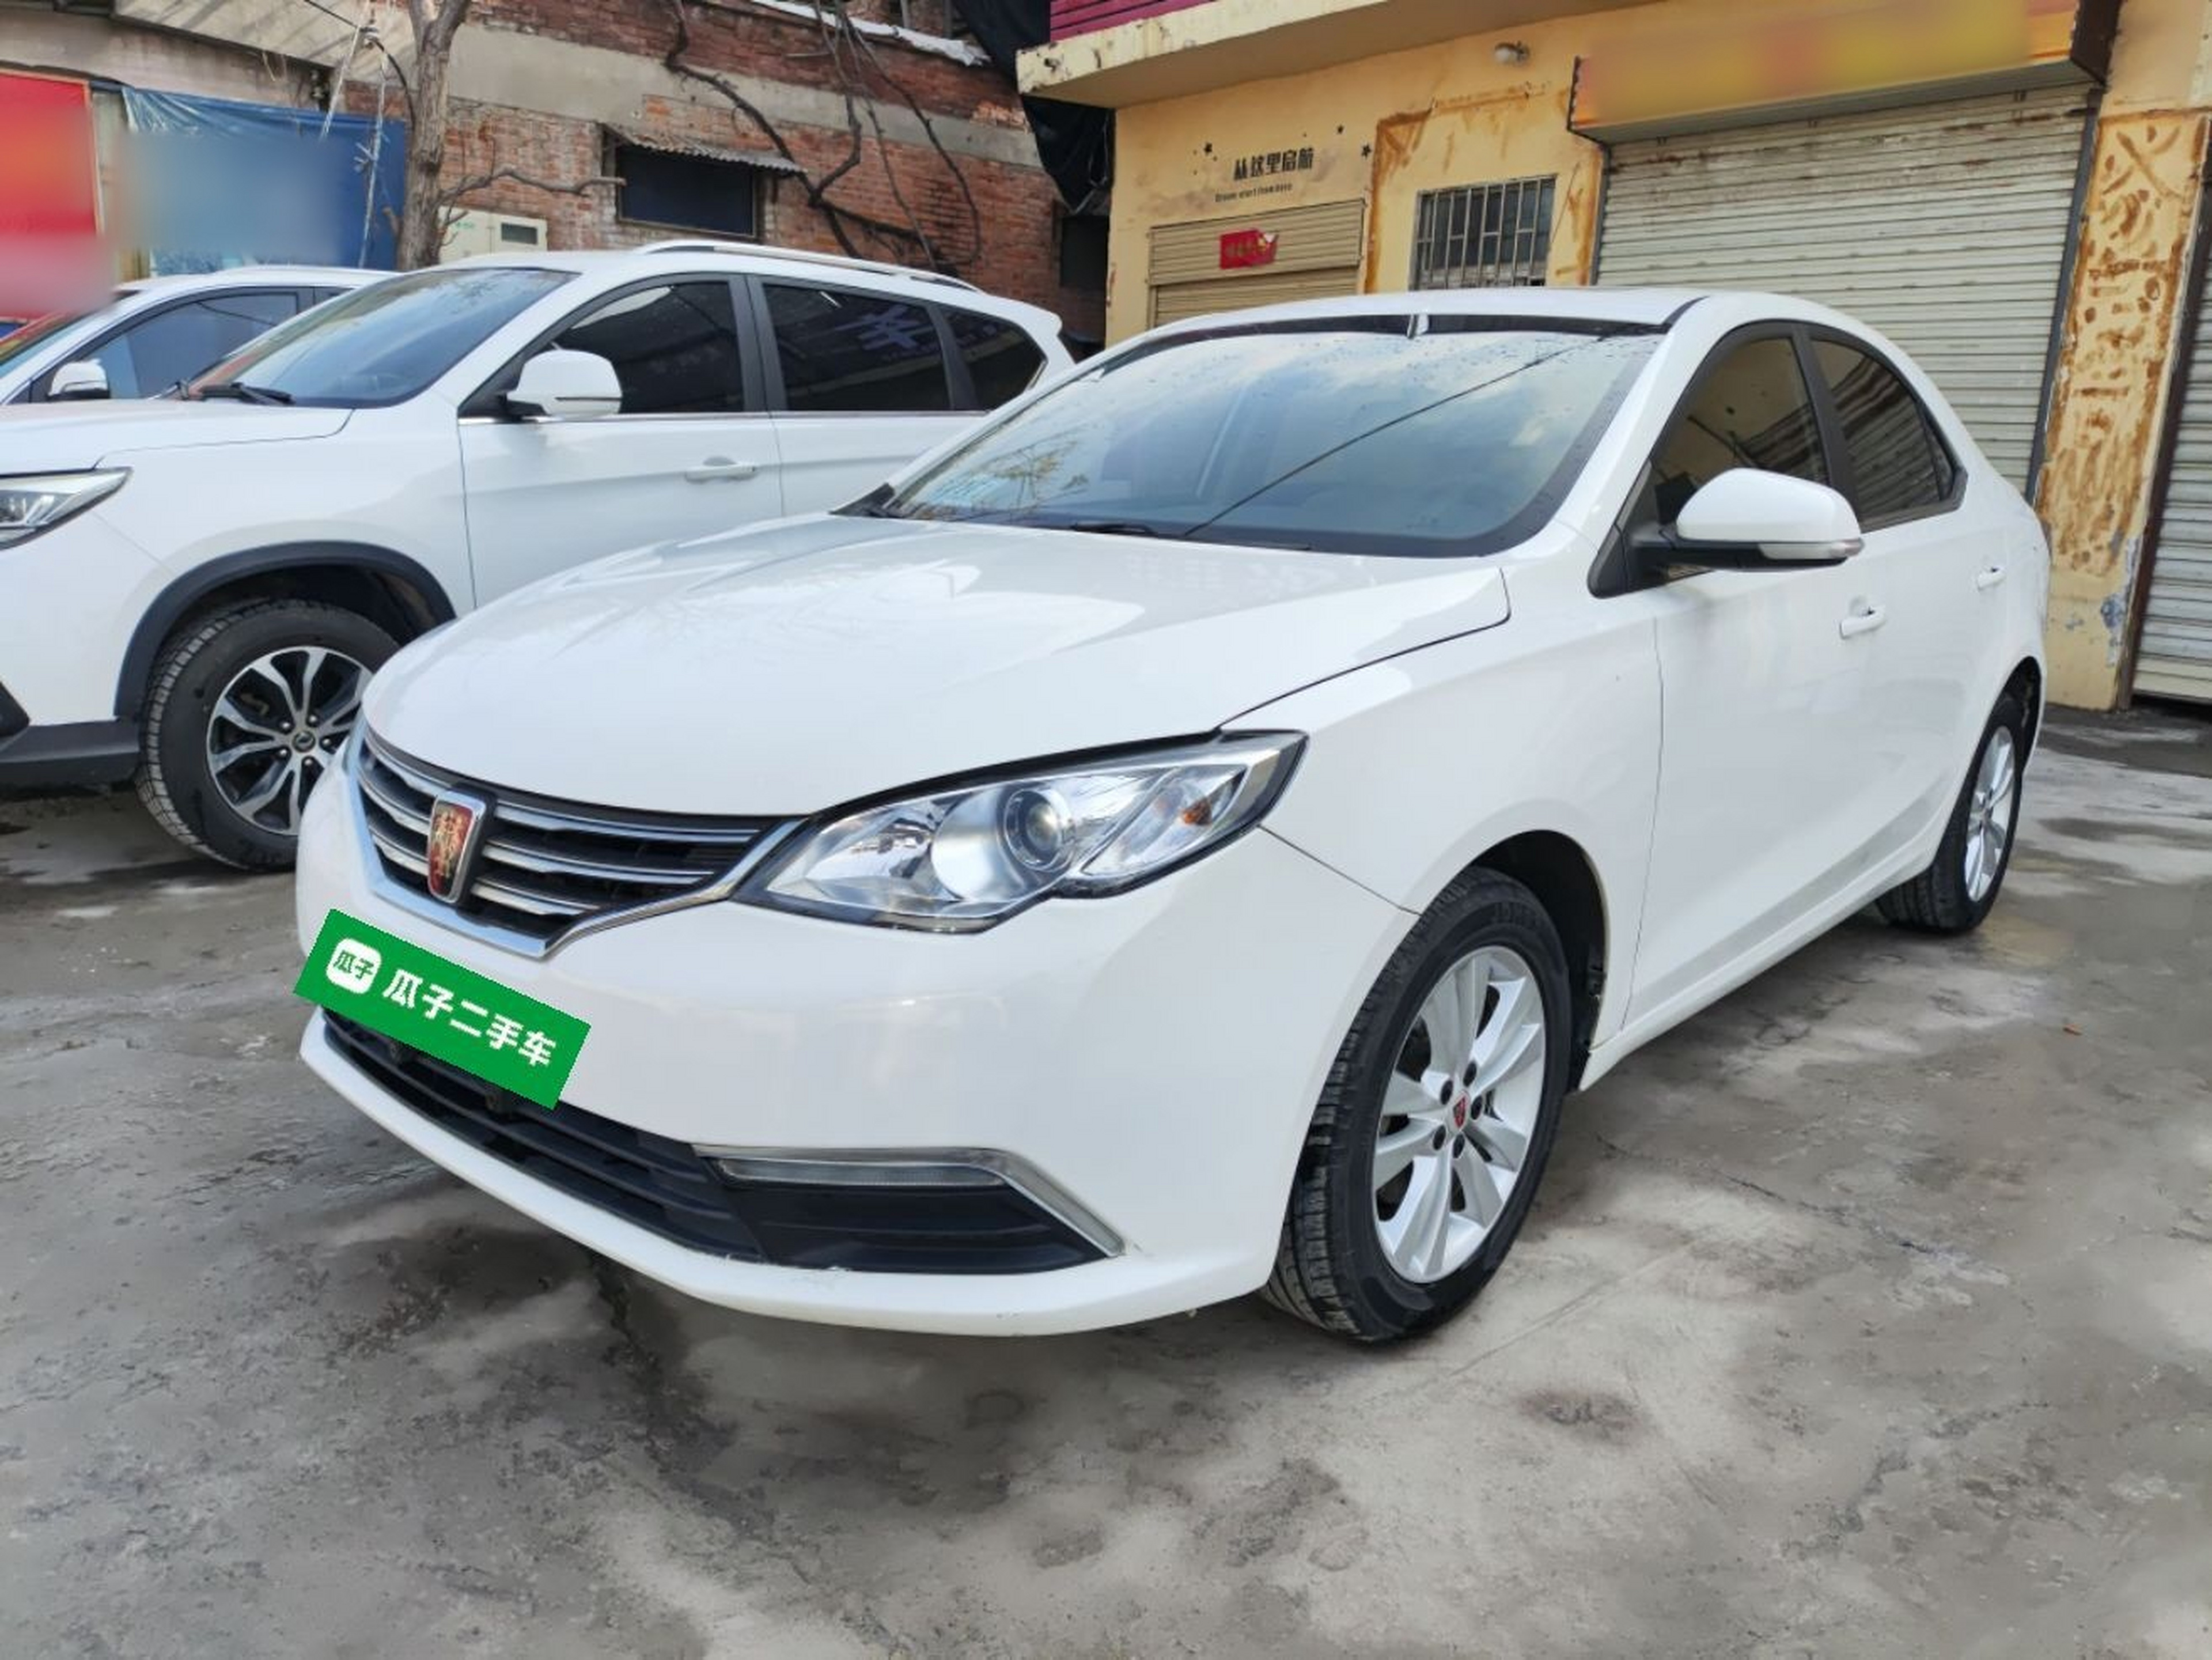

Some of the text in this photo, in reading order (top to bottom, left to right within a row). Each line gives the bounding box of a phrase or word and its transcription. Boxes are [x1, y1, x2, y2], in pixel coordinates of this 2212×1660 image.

[1234, 148, 1314, 181] 从这里启航
